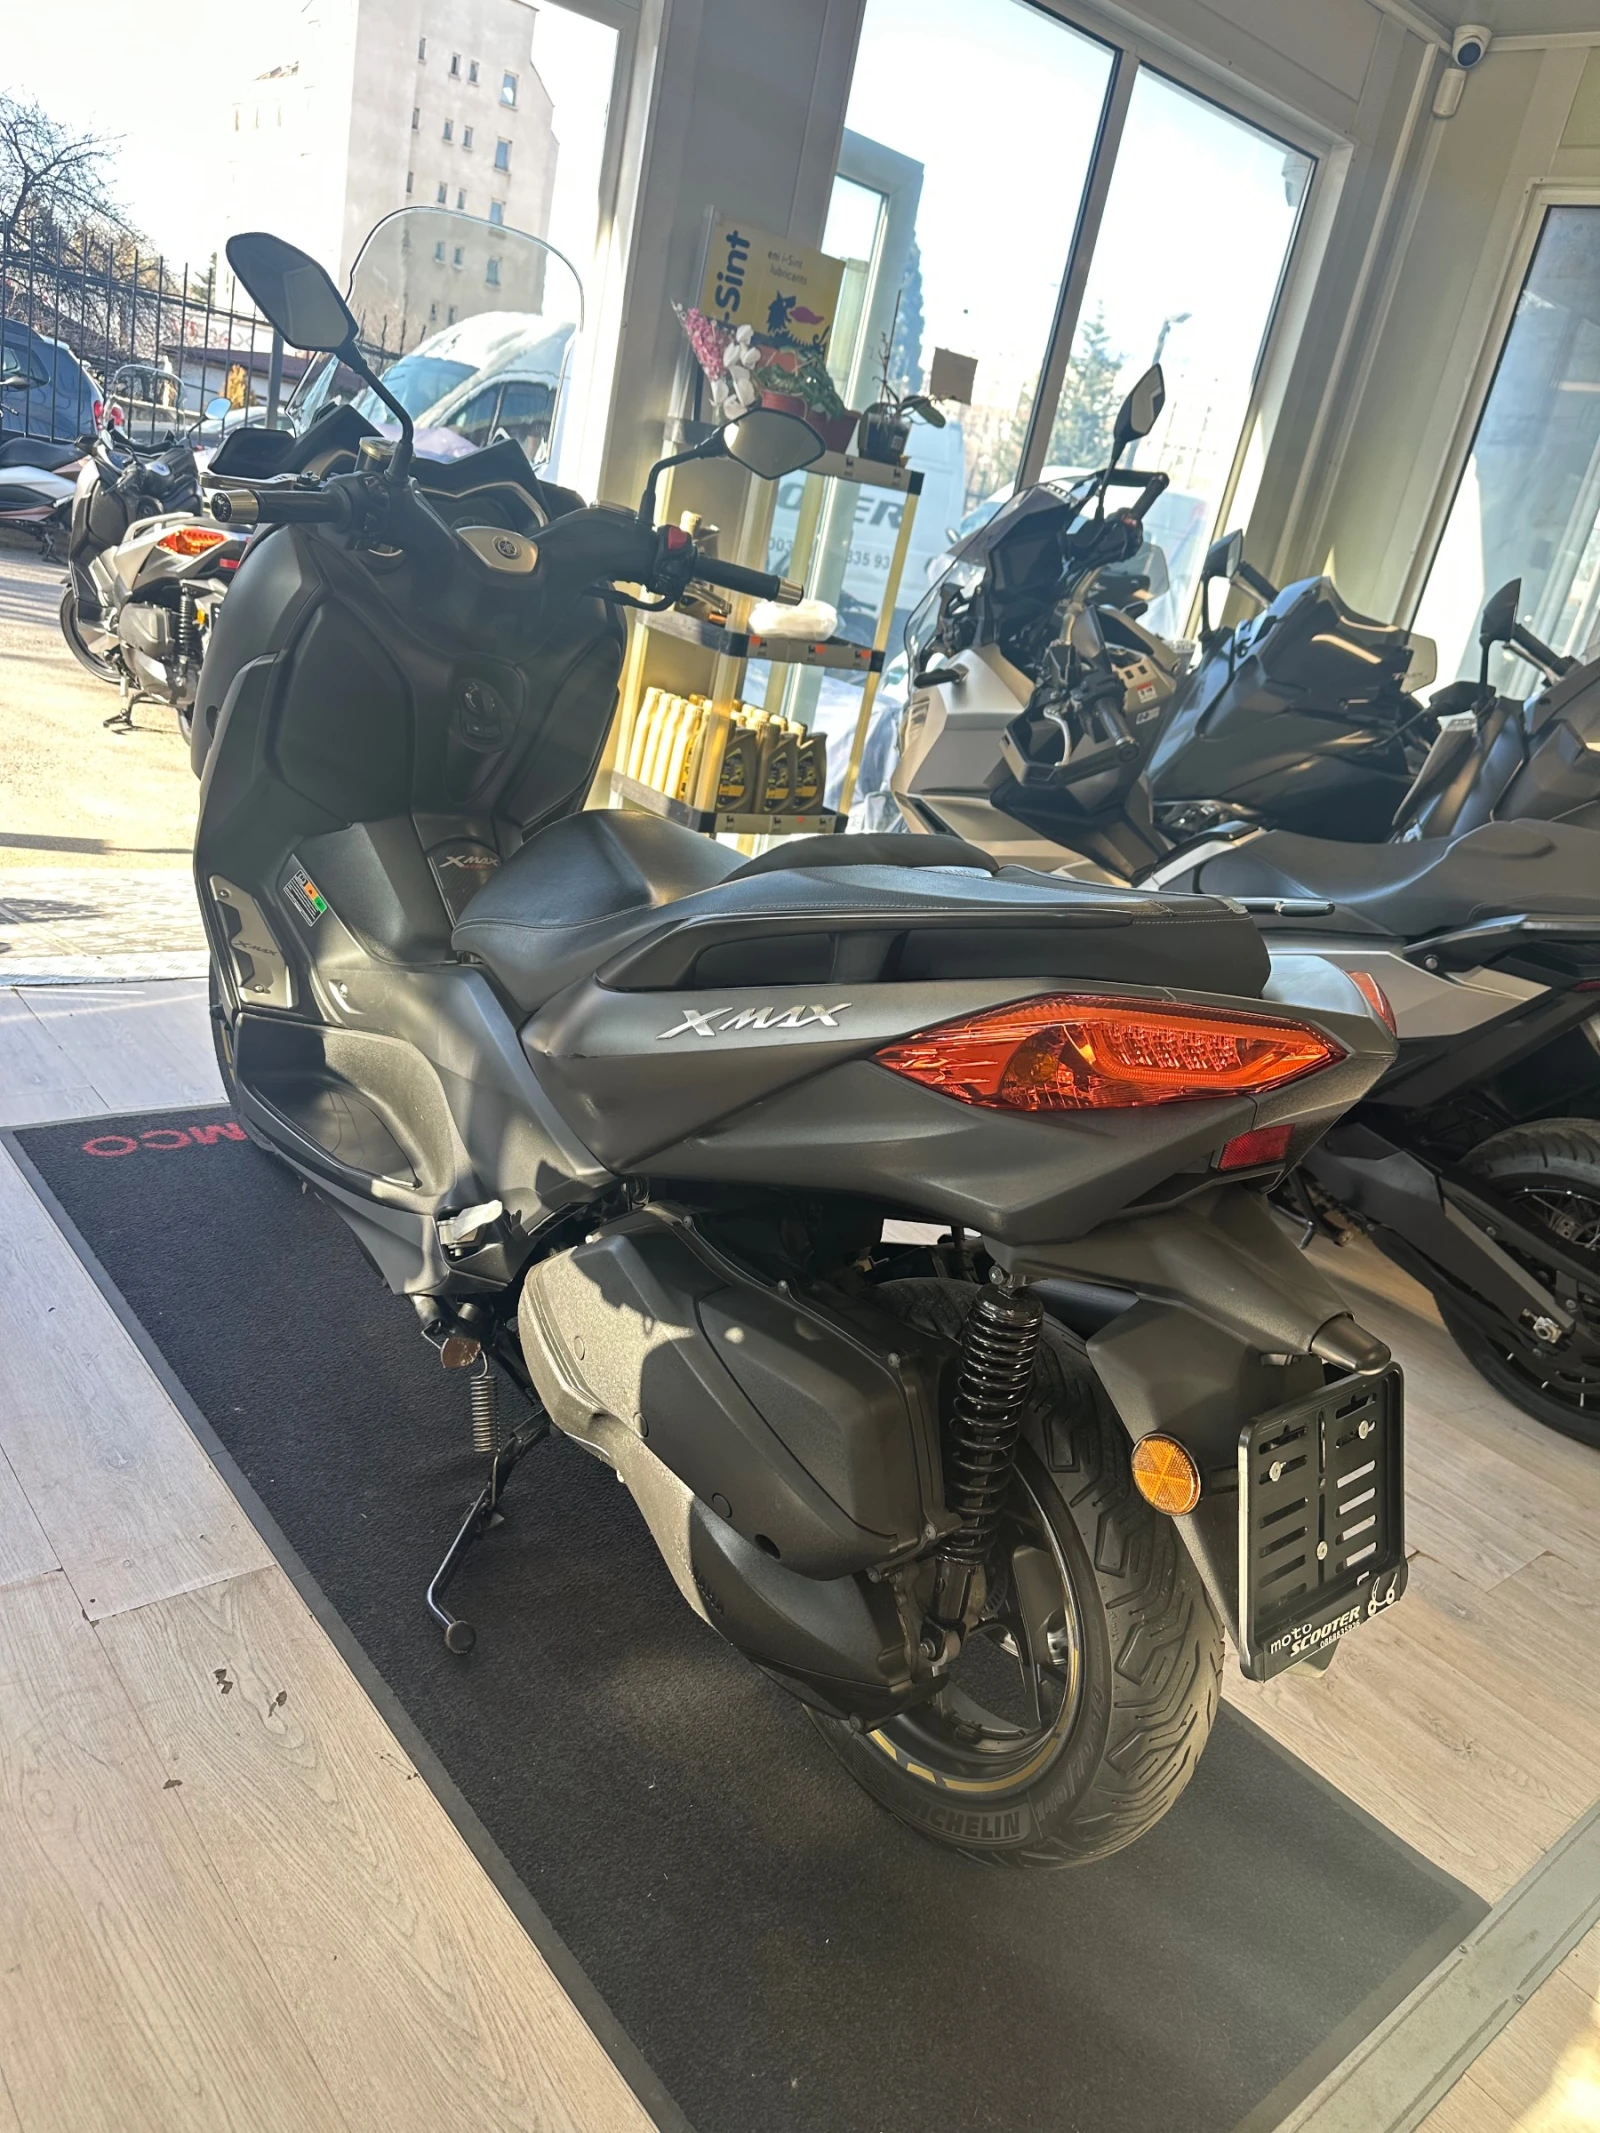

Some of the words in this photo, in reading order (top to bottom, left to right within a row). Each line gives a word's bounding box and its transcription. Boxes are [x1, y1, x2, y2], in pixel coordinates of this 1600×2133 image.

[81, 1121, 249, 1158] MCO
[1269, 1622, 1313, 1655] moto
[1289, 1604, 1362, 1658] SCOOTER
[903, 1795, 1021, 1839] MICHELIN
